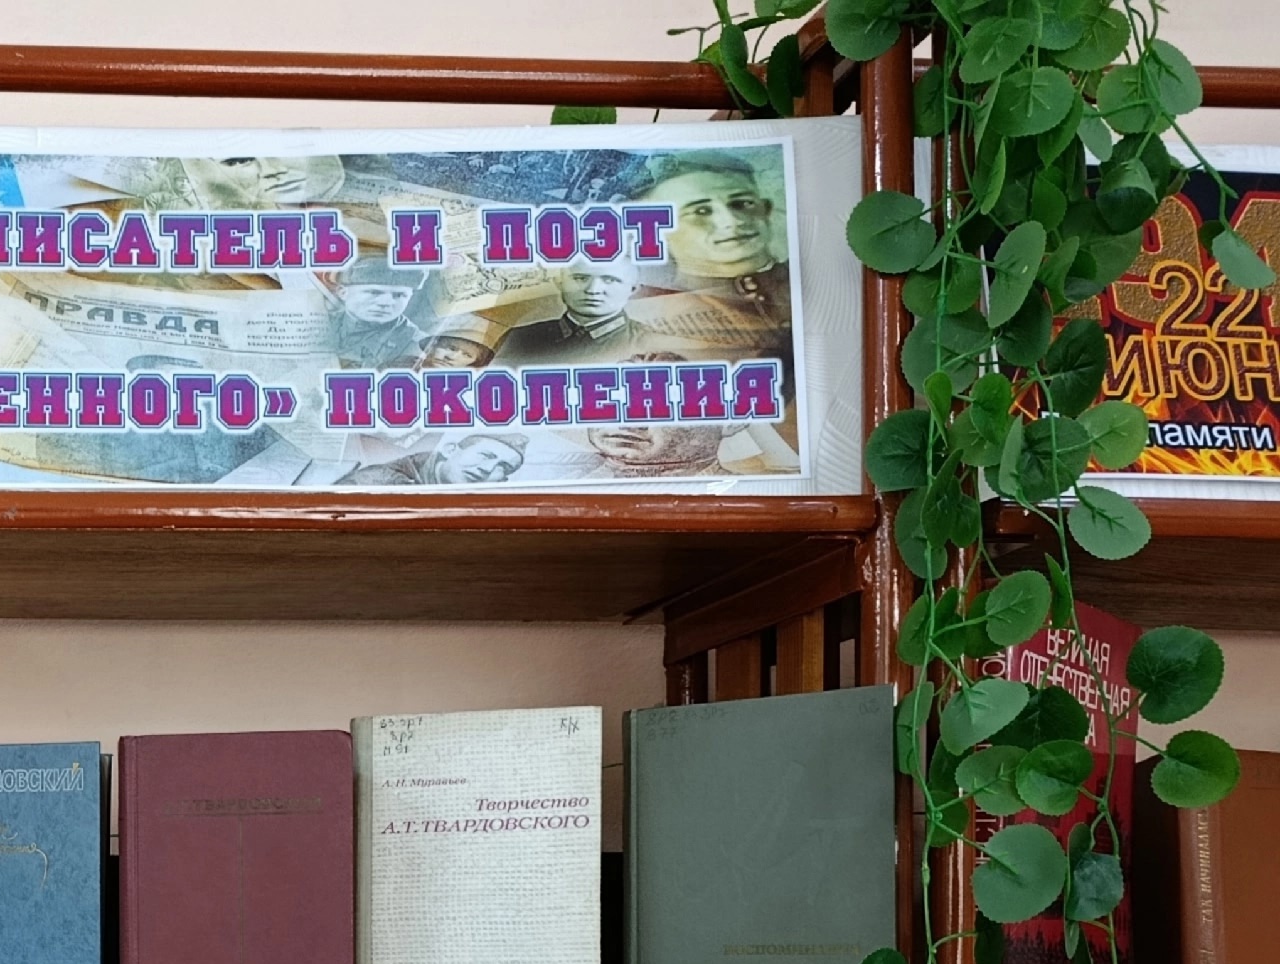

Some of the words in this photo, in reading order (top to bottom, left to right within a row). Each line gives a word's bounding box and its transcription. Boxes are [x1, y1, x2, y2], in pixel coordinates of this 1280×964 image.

[392, 211, 442, 267] И
[483, 207, 673, 264] ПОЭТ
[24, 291, 220, 334] ПРАВДА
[323, 362, 781, 429] ПОКОЛЕНИЯ
[476, 797, 590, 813] Творчество
